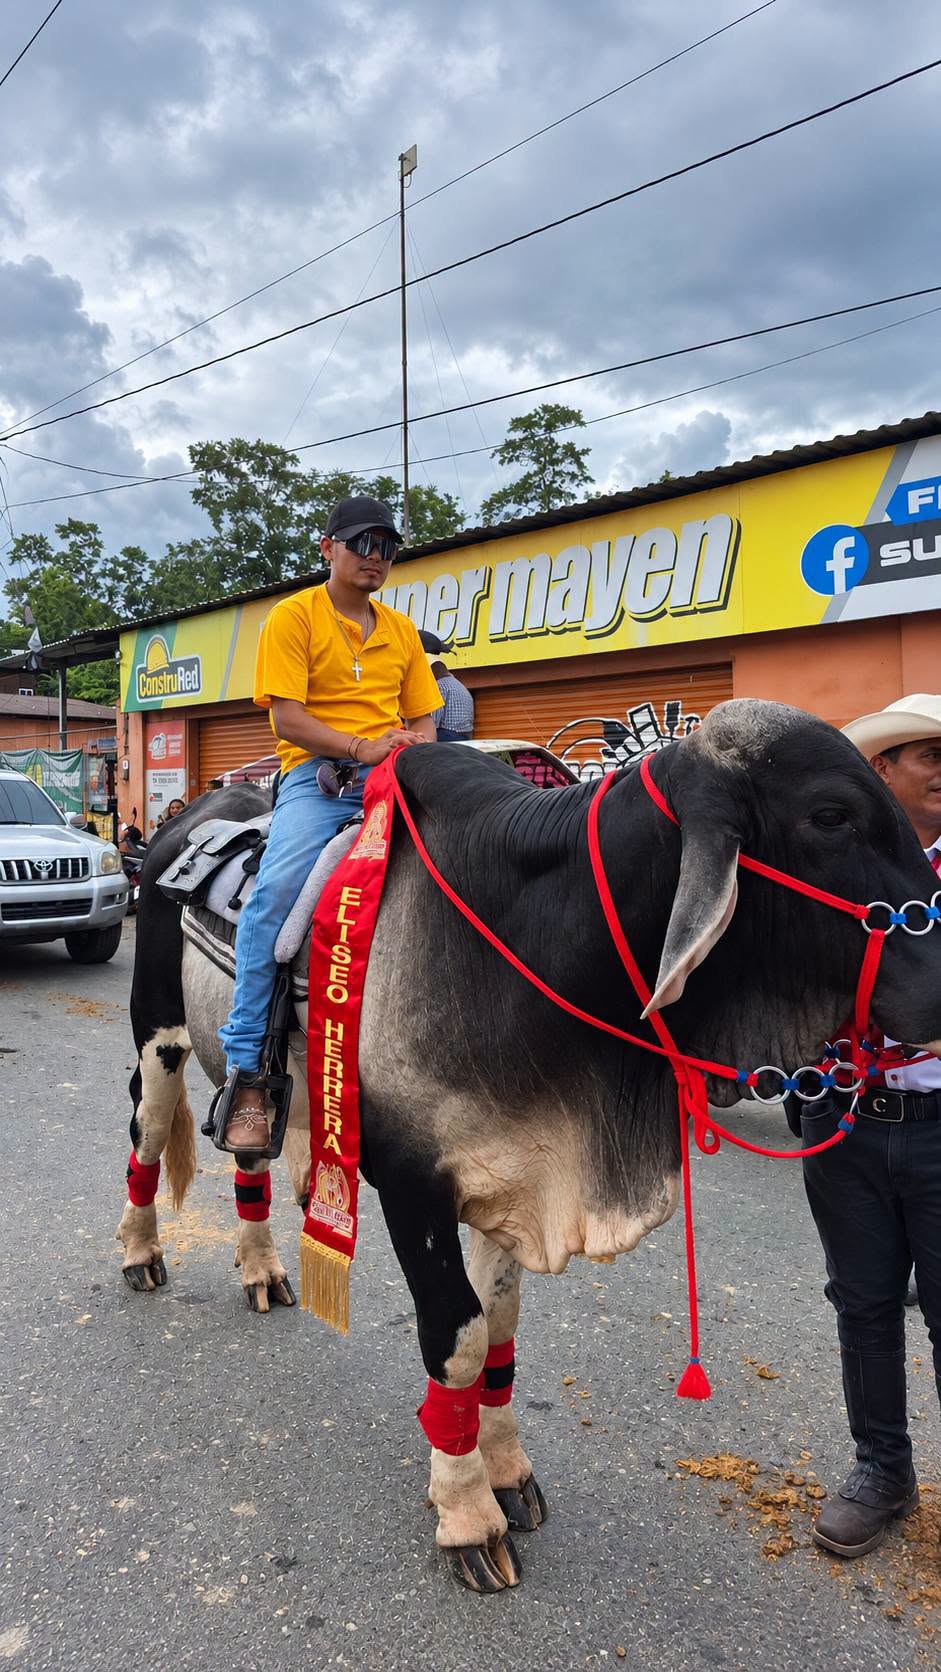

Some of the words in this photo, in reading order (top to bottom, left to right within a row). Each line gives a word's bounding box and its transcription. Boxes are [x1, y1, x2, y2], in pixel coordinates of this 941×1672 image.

[908, 485, 941, 514] F
[489, 513, 739, 638] mayen
[140, 664, 199, 697] ConstruRed
[326, 886, 362, 1004] ELISEO
[323, 1018, 344, 1156] HERRERA
